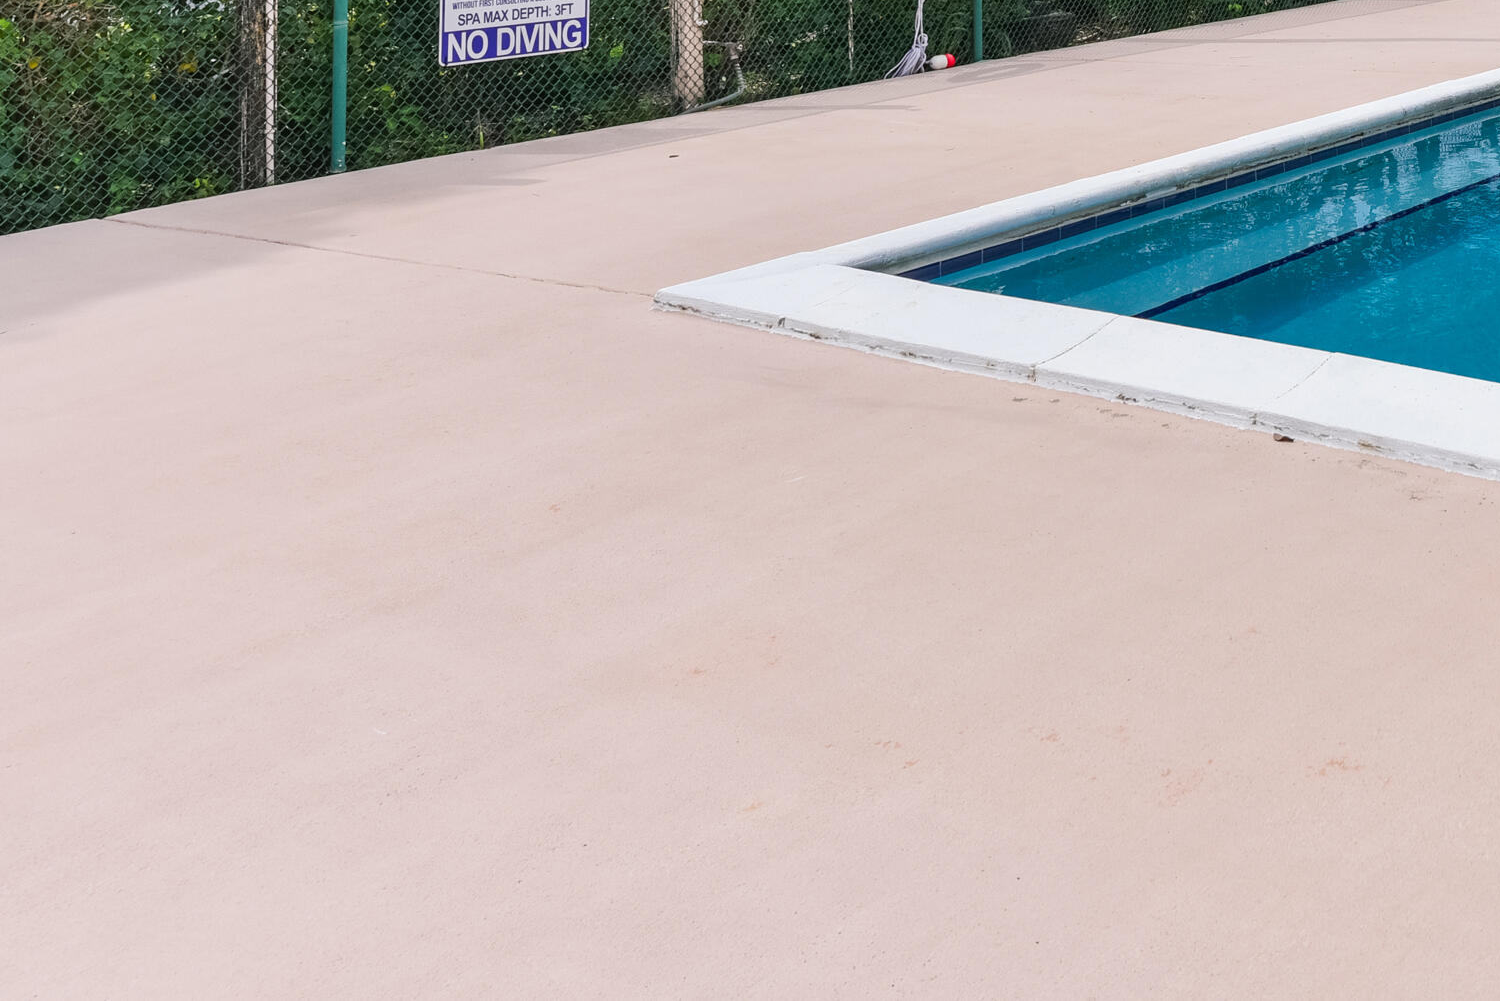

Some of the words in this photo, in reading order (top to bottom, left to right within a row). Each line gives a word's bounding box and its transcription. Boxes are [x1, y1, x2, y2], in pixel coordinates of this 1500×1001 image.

[453, 2, 477, 10] WITHOUT
[479, 0, 494, 8] FIRST
[458, 13, 480, 26] SPA
[484, 10, 508, 23] MAX
[512, 6, 551, 20] DEPTH:
[555, 3, 574, 16] 3FT
[447, 30, 488, 62] NO
[497, 20, 581, 56] DIVING
